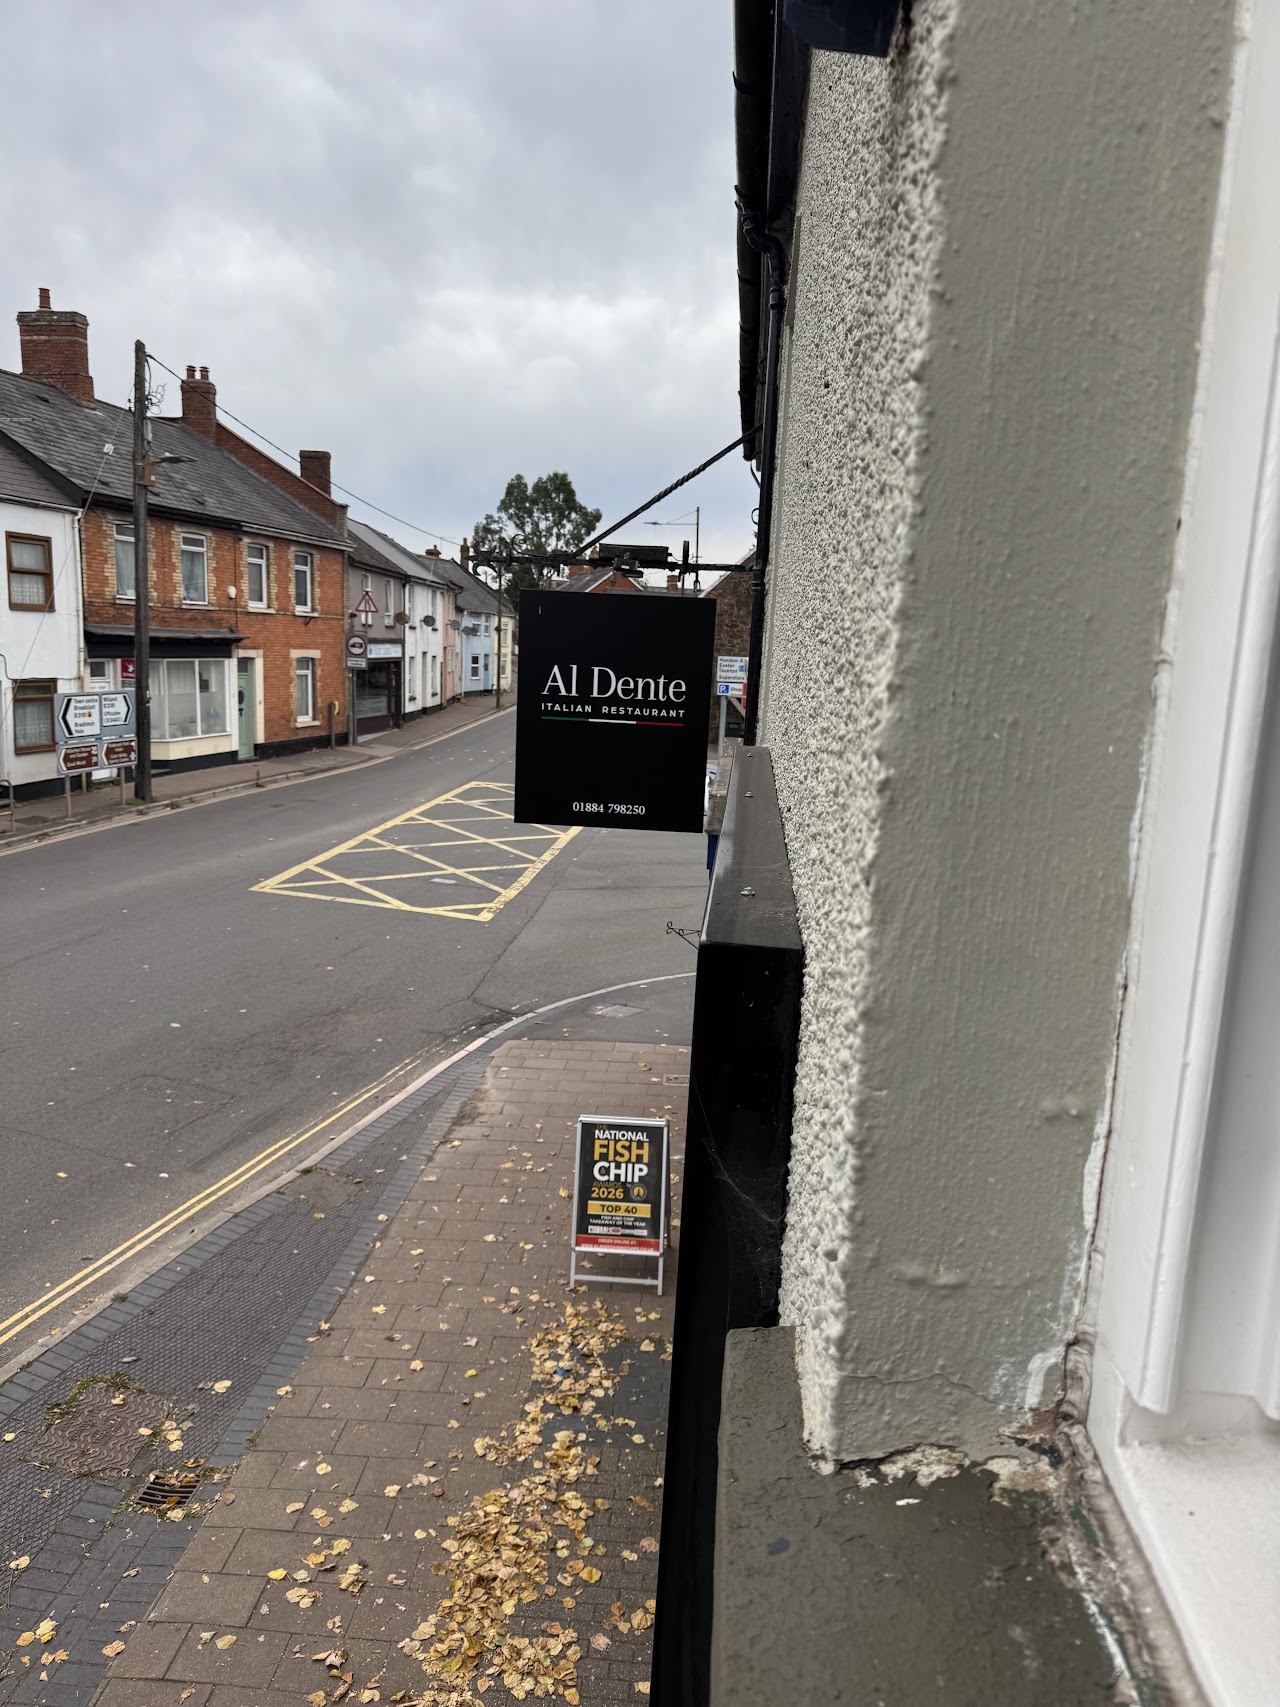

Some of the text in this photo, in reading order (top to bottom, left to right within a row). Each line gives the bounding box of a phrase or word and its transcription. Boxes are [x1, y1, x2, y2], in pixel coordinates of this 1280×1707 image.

[541, 664, 687, 703] Al Dente
[541, 702, 686, 718] ITALIAN RESTAURANT
[572, 801, 646, 815] 01884 798250
[595, 1130, 649, 1141] NATIONAL
[594, 1140, 649, 1163] FISH
[593, 1161, 648, 1183] CHIP
[591, 1187, 624, 1199] 2026
[600, 1204, 638, 1215] TOP 40
